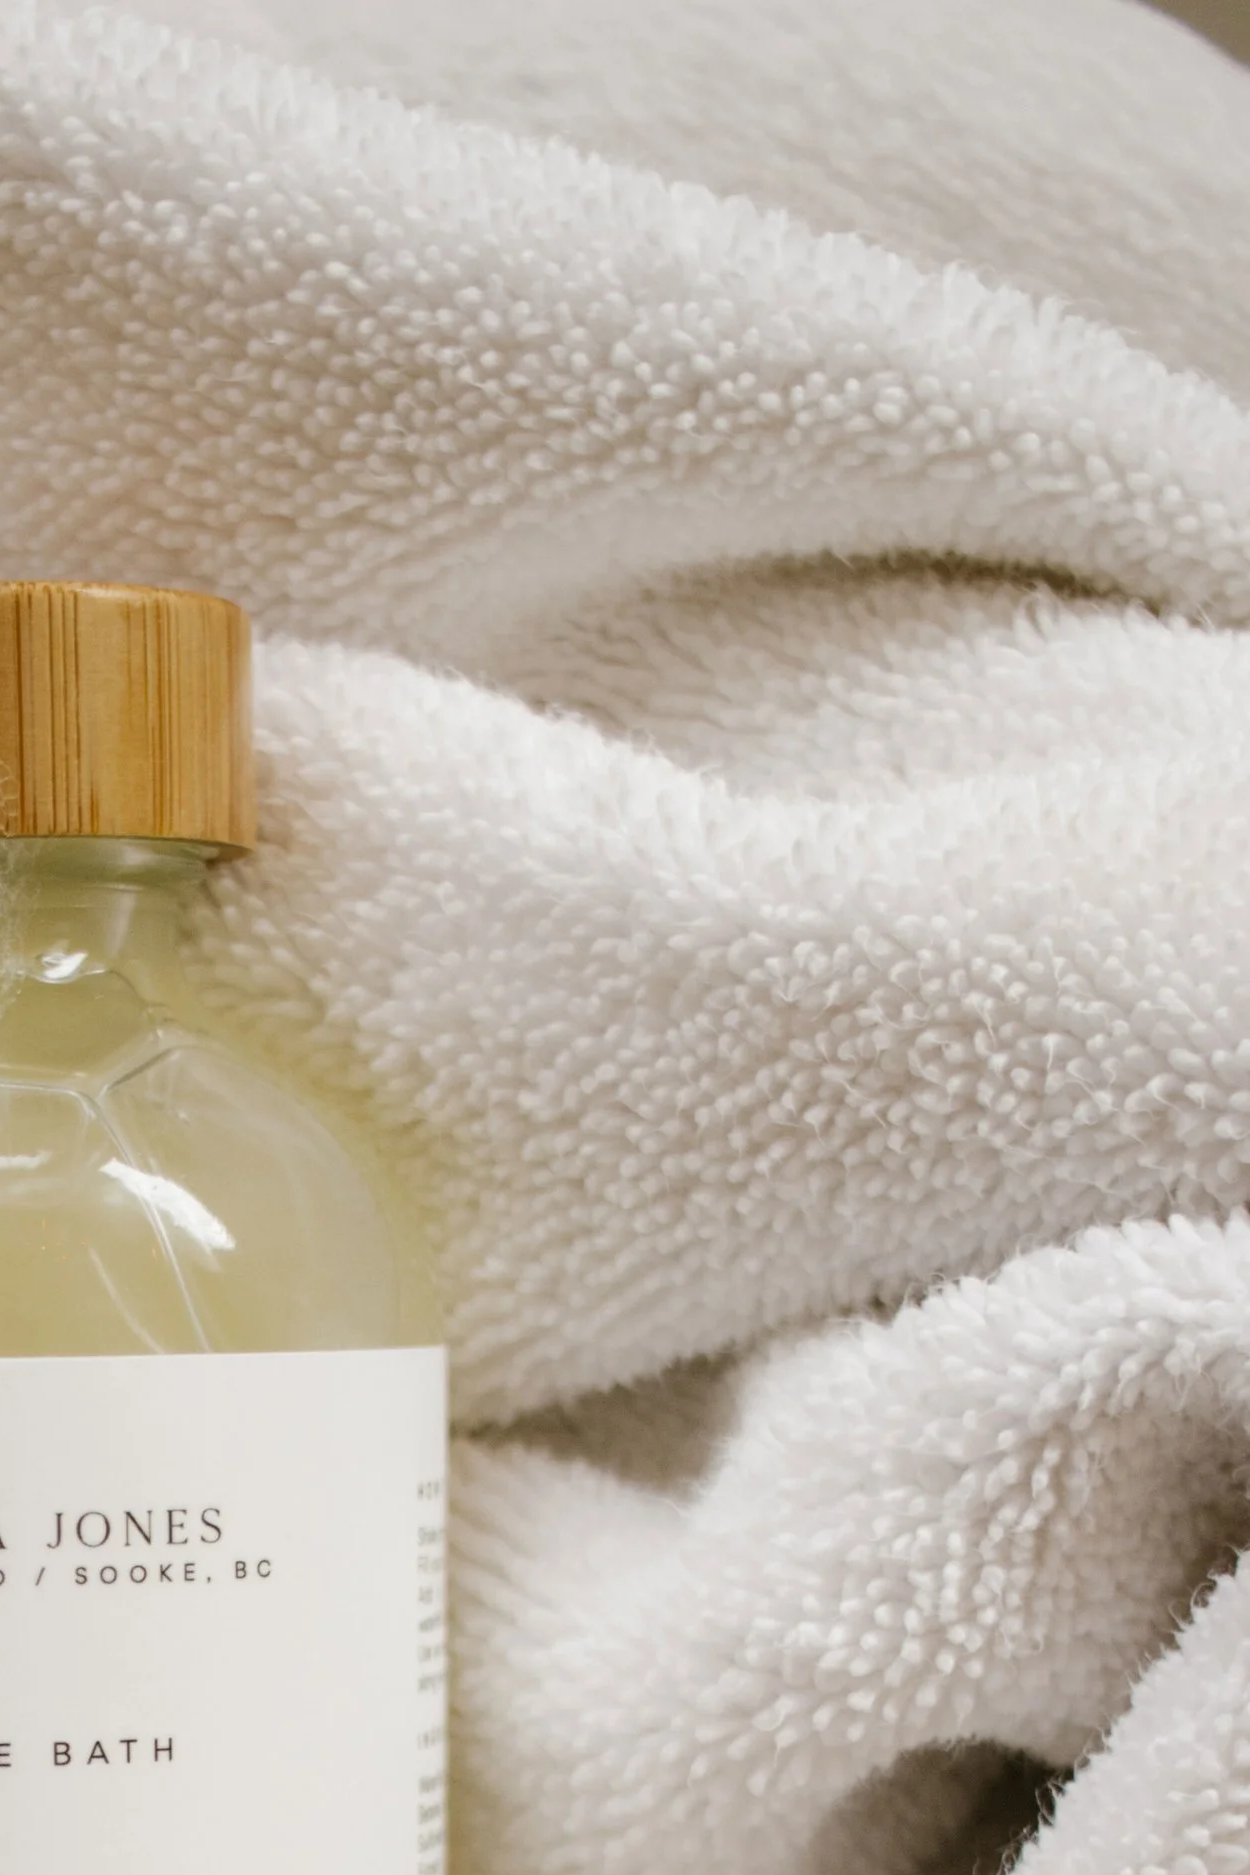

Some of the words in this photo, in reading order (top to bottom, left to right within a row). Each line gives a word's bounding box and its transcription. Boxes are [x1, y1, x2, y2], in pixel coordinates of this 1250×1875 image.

[46, 1508, 222, 1549] JONES
[75, 1562, 211, 1586] SOOKE,
[235, 1558, 271, 1580] BC
[53, 1737, 173, 1767] BATH
